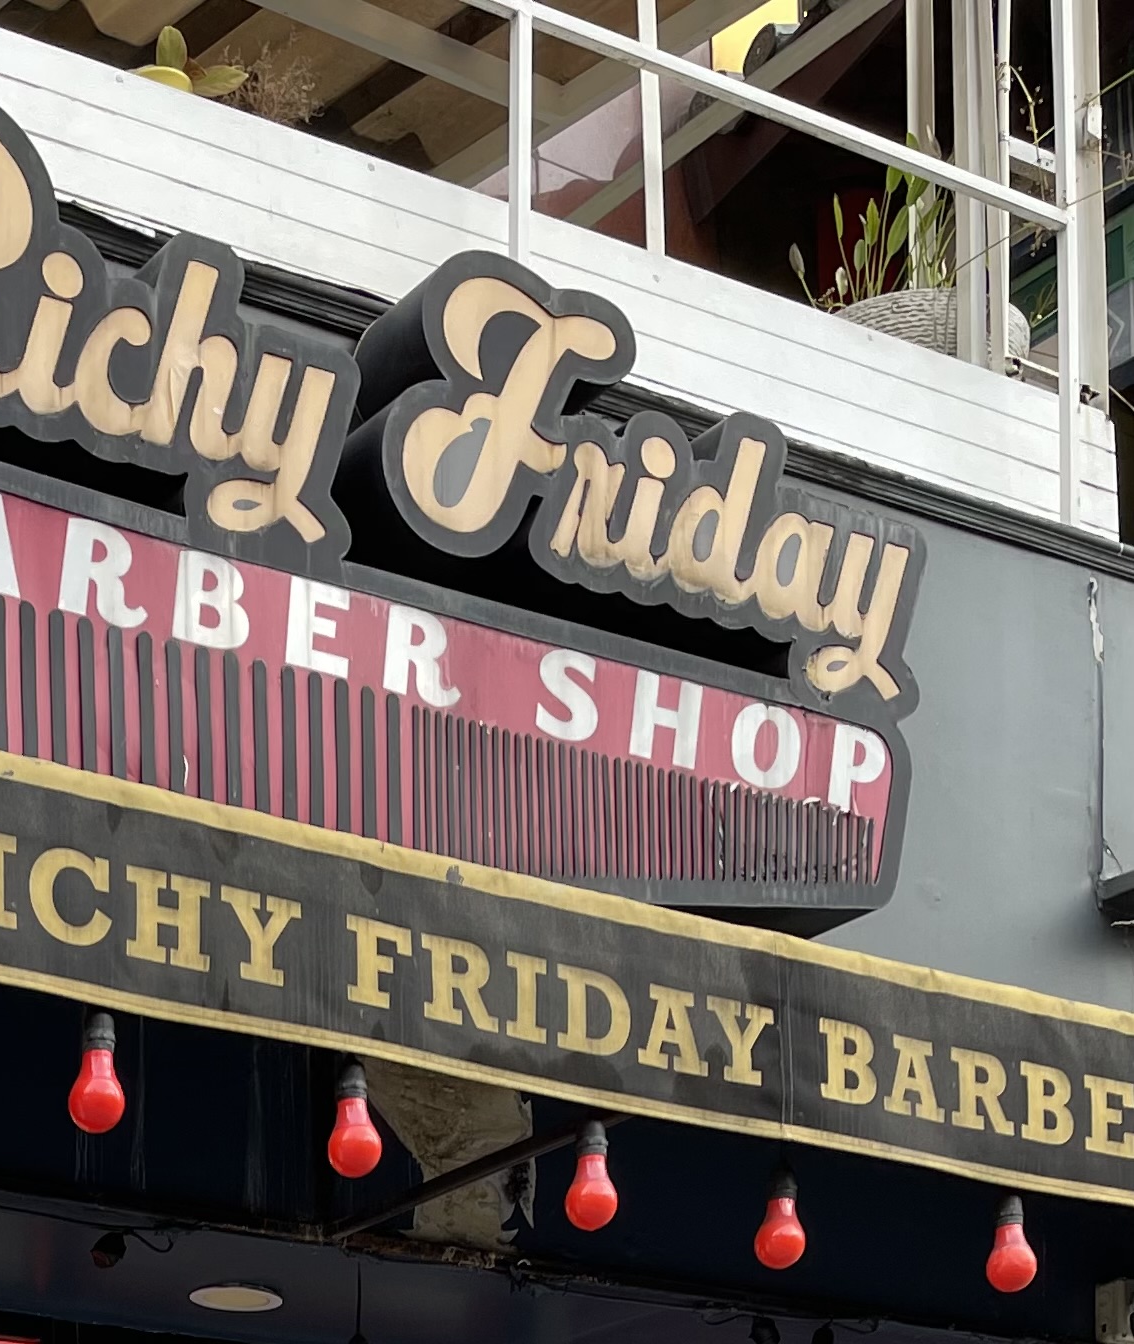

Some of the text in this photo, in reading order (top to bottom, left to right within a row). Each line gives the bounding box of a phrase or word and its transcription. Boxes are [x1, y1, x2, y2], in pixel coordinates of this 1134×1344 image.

[401, 275, 909, 701] Friday
[535, 649, 886, 812] SHOP
[346, 912, 774, 1087] FRIDAY
[820, 1017, 1134, 1157] BARBE
